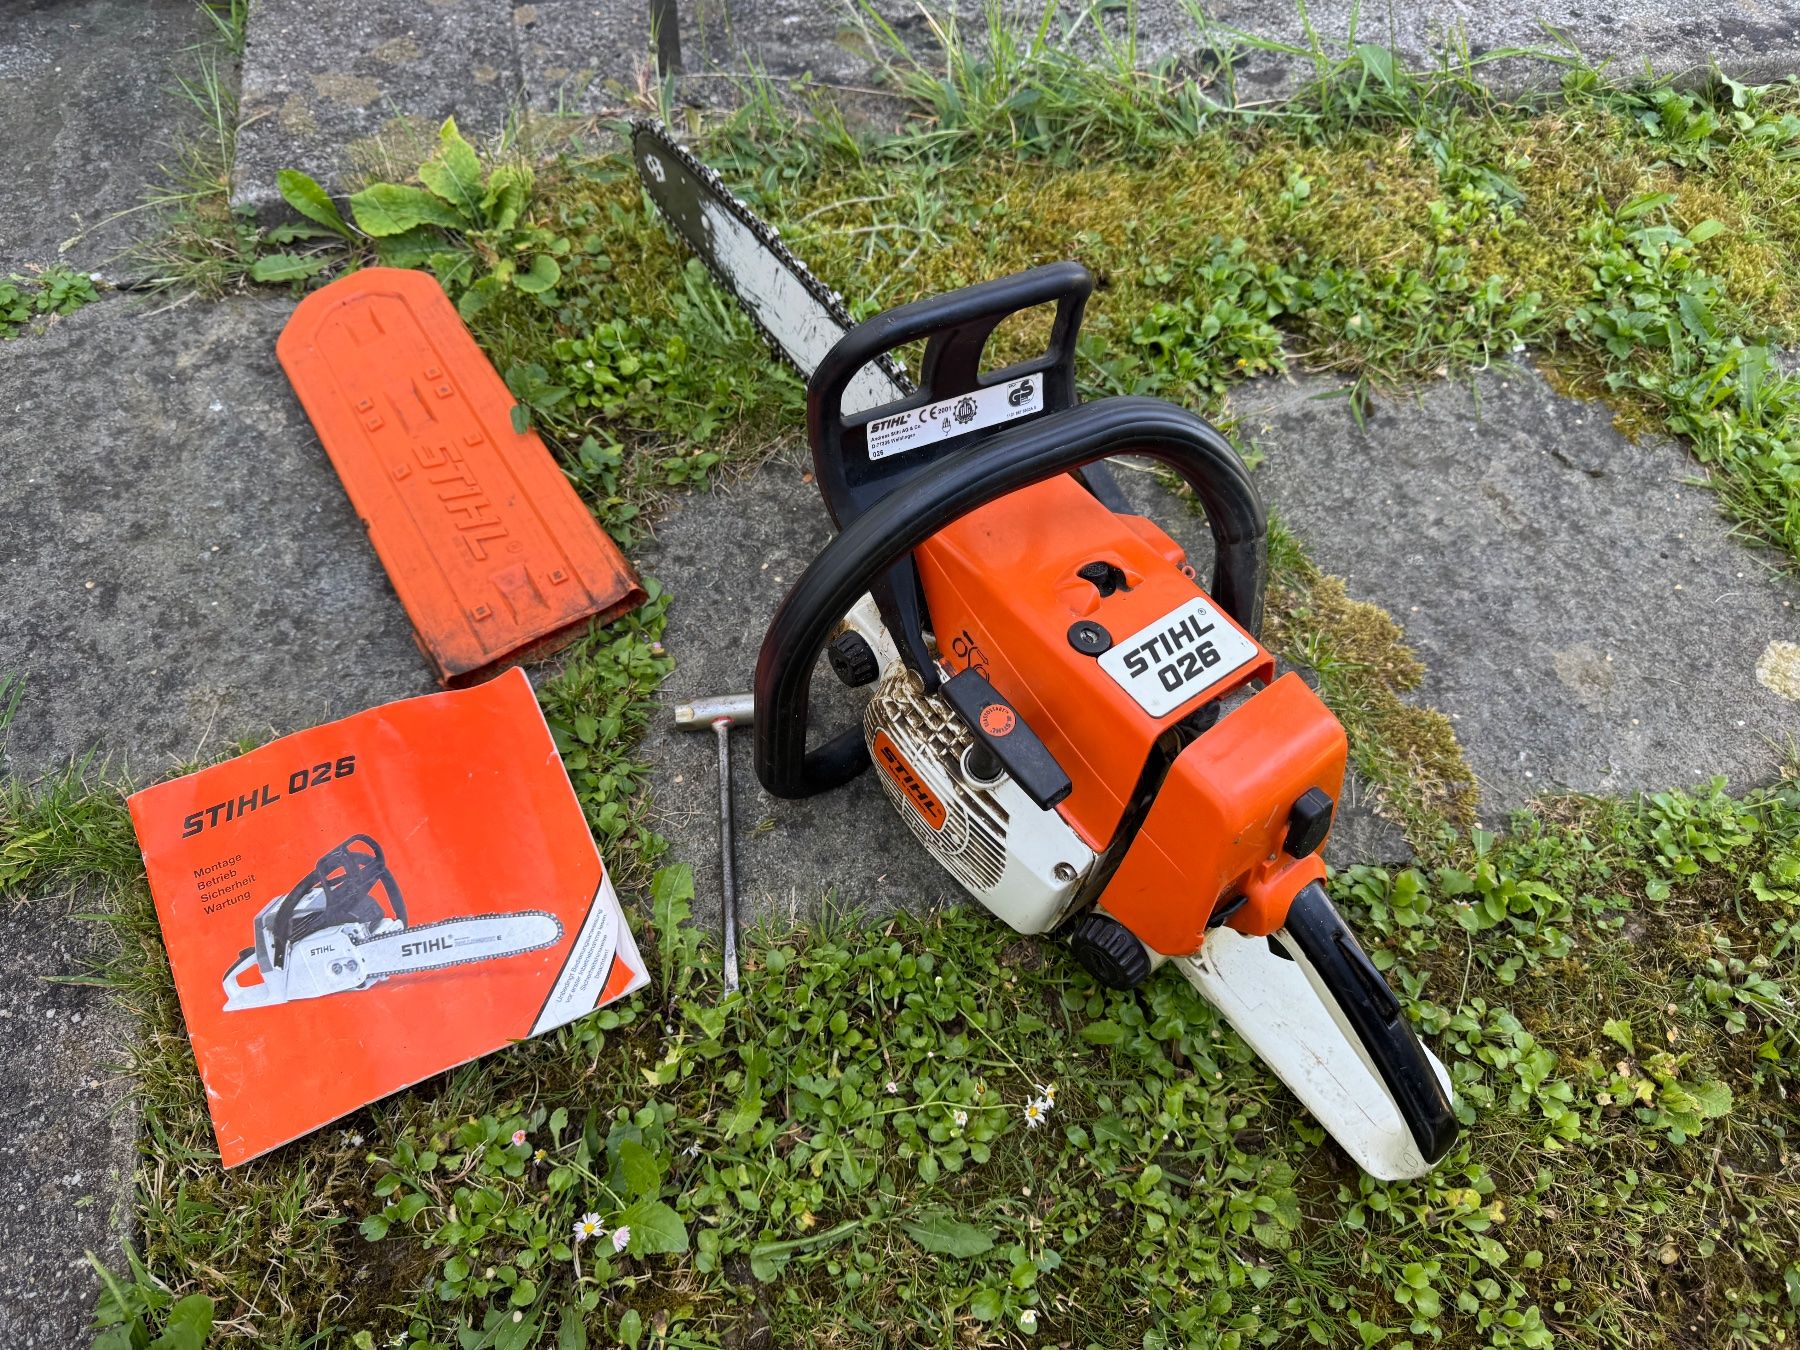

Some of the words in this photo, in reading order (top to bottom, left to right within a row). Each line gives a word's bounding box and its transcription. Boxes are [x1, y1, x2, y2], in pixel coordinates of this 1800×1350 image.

[871, 415, 908, 434] STIHL
[873, 450, 884, 458] 026
[411, 441, 509, 562] STIHL
[1123, 614, 1215, 679] STIHL
[1157, 640, 1221, 693] 026
[880, 746, 937, 817] STIHL
[181, 784, 281, 839] STIHL
[288, 755, 357, 795] 026
[193, 853, 242, 879] Montage
[197, 868, 237, 891] Betrieb
[200, 874, 257, 903] Sicherheit
[203, 890, 252, 915] Wartung
[310, 944, 336, 957] STIHL
[401, 937, 453, 958] STIHL
